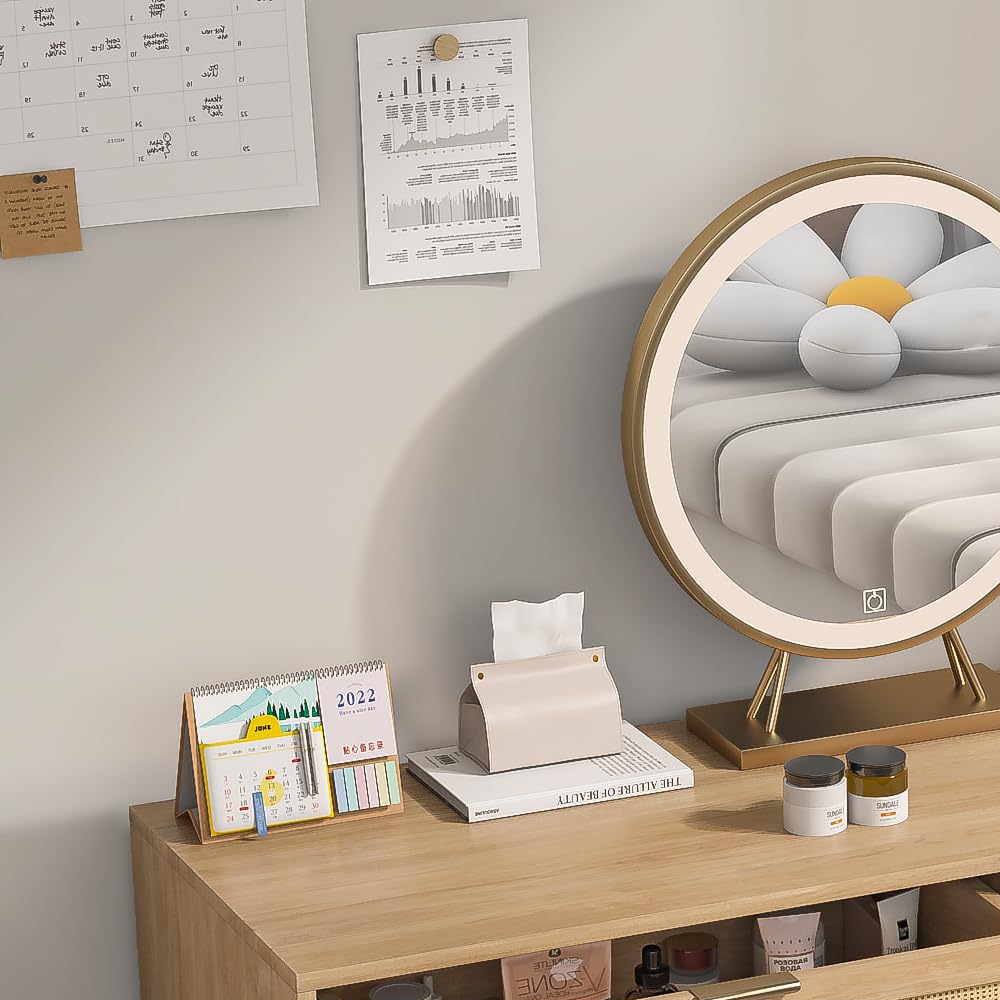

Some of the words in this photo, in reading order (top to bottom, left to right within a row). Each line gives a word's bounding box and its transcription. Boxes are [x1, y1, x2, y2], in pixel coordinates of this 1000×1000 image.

[337, 688, 376, 707] 2022
[343, 740, 384, 755] 贴心备忘录
[617, 780, 658, 795] ALLURE
[660, 776, 682, 788] THE
[557, 789, 599, 805] BEAUTY
[601, 787, 616, 798] OF
[774, 958, 808, 966] РОЗОВАЯ
